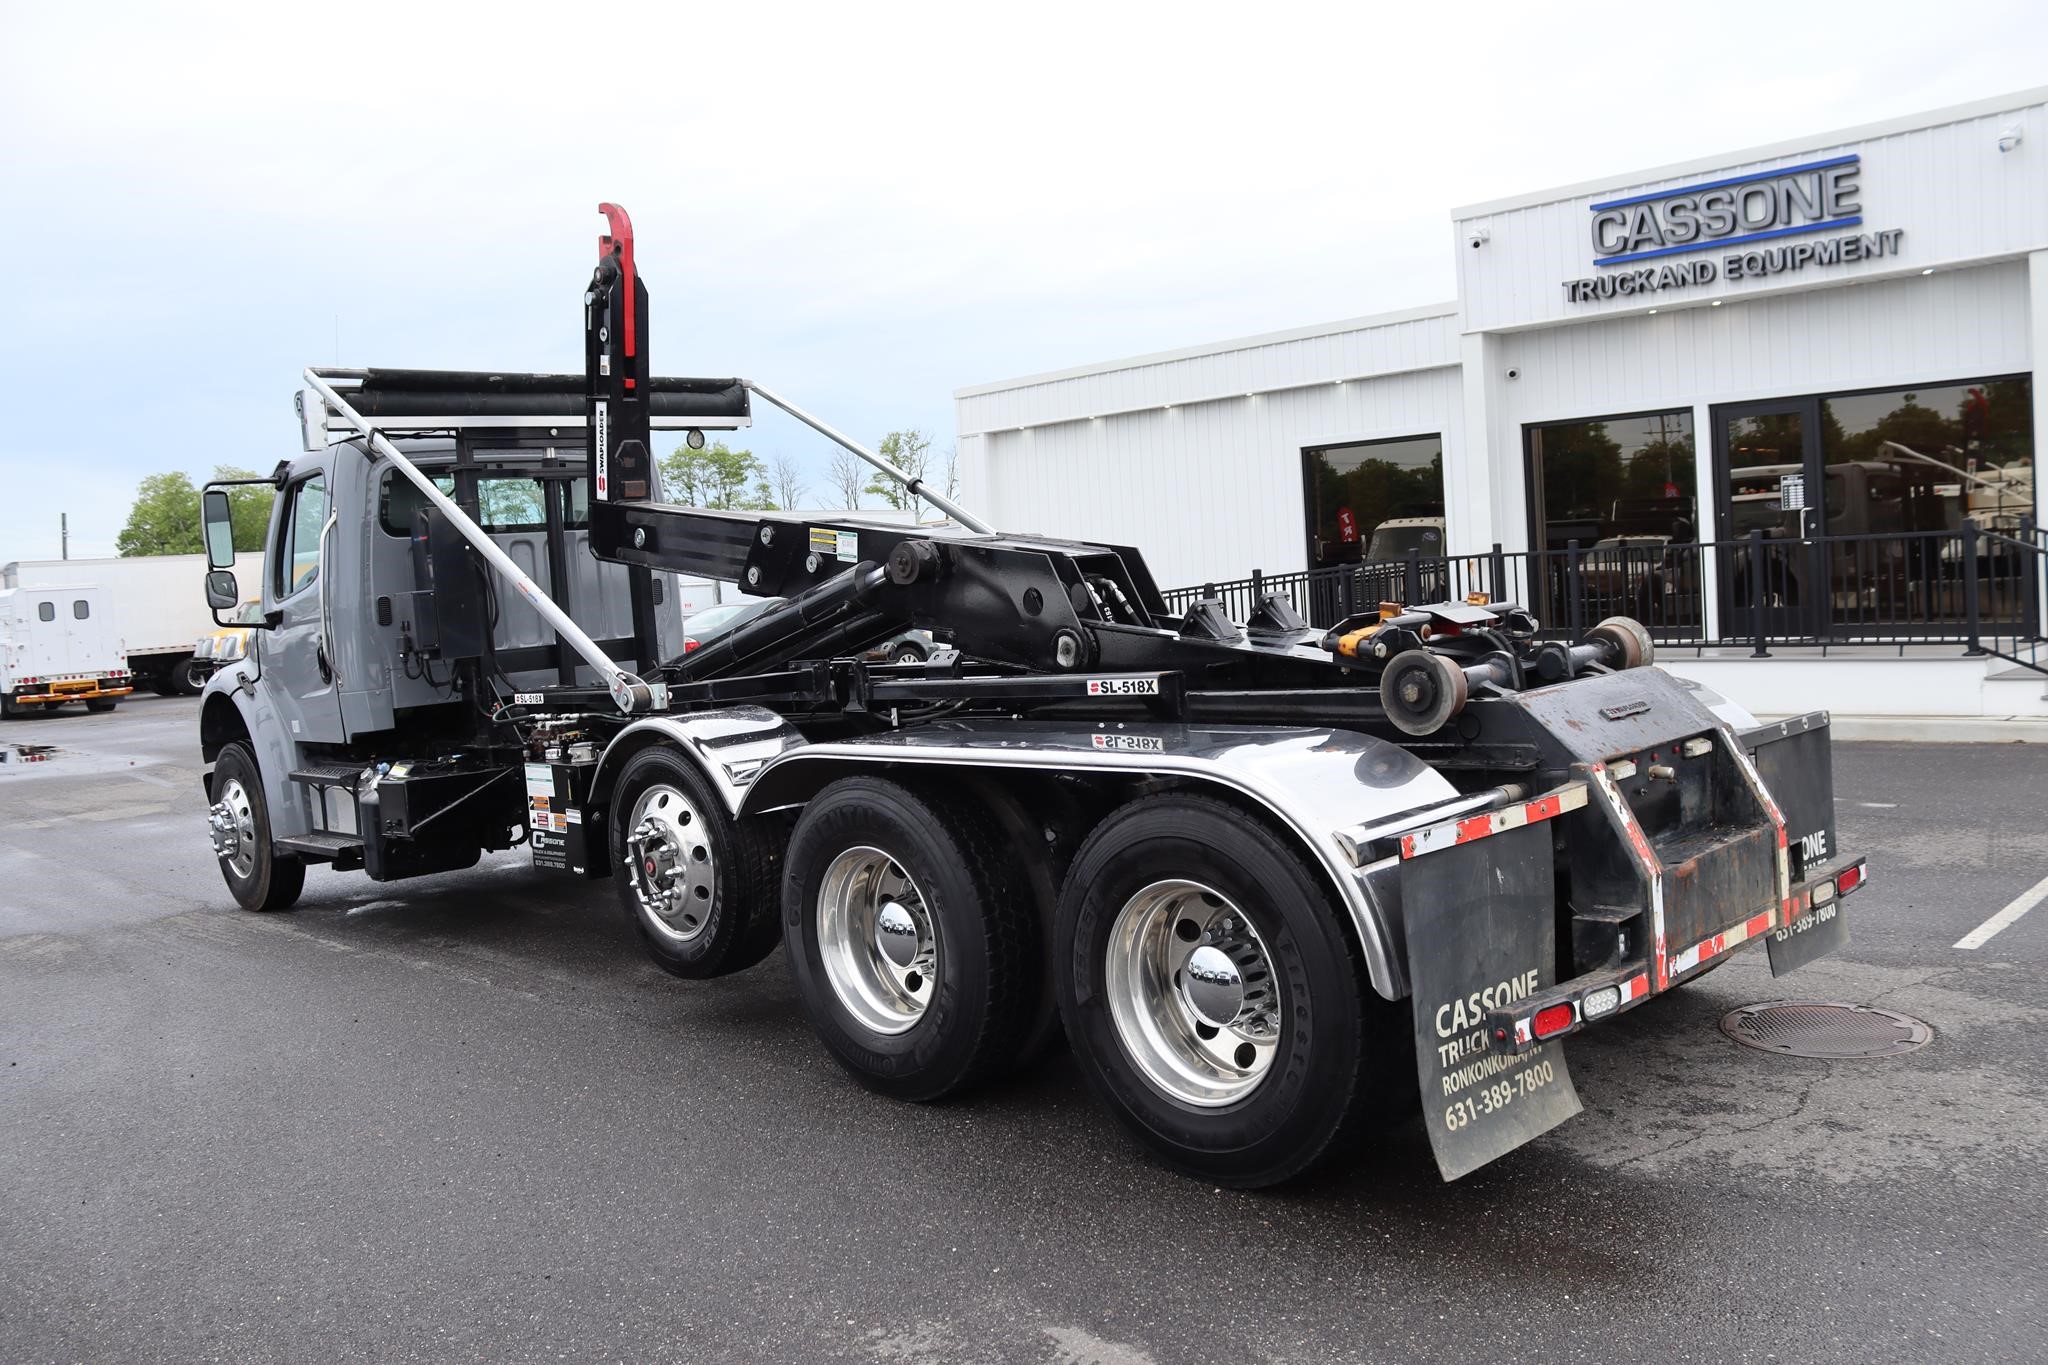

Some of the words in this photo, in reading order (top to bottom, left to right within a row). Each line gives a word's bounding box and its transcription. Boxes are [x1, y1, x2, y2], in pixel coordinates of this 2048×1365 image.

[1592, 164, 1861, 254] CASSONE
[1723, 228, 1903, 281] EQUIPMENT
[520, 694, 543, 703] SL-518X
[1100, 680, 1156, 693] SL-518X
[1445, 1060, 1553, 1131] 631-389-7800
